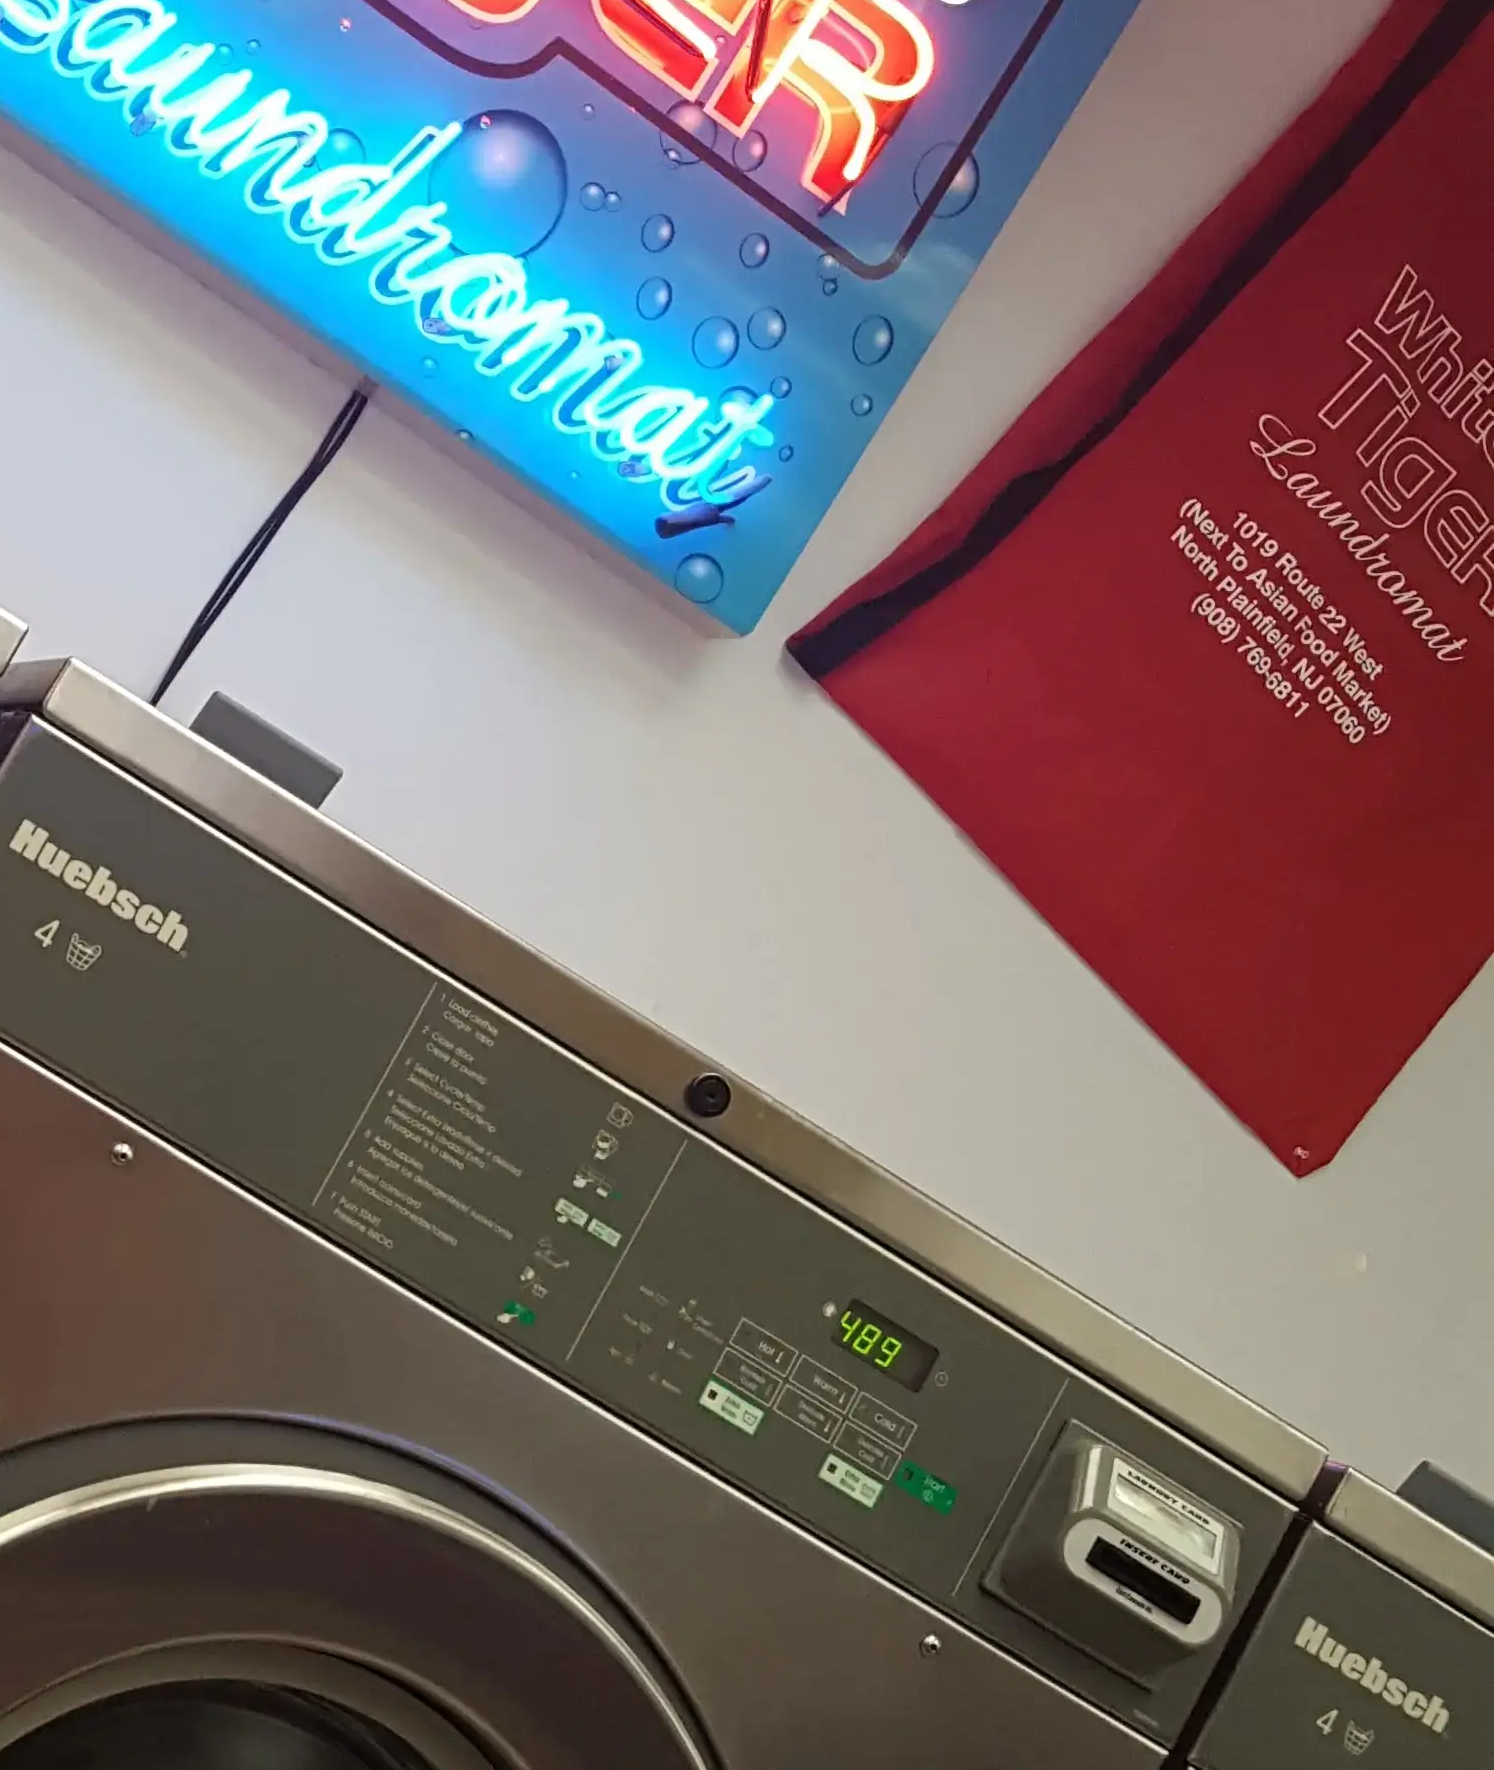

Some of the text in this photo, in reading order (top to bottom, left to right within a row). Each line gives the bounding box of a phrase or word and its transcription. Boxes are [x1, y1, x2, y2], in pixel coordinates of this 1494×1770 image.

[1375, 264, 1494, 465] Whit
[1233, 512, 1385, 682] 1019 Route 22 West
[1250, 414, 1470, 663] Laundromat
[1171, 525, 1366, 744] North Plainfield, NJ 07060
[1179, 498, 1391, 736] (Next To Asian Food Market)
[1190, 591, 1309, 719] (908) 769-6811
[9, 818, 189, 951] Huebsch
[34, 920, 62, 948] 4
[841, 1310, 901, 1368] 489
[1119, 1538, 1191, 1585] INSERT CARD
[1294, 1615, 1451, 1734] Huebsch
[1316, 1709, 1339, 1735] 4
